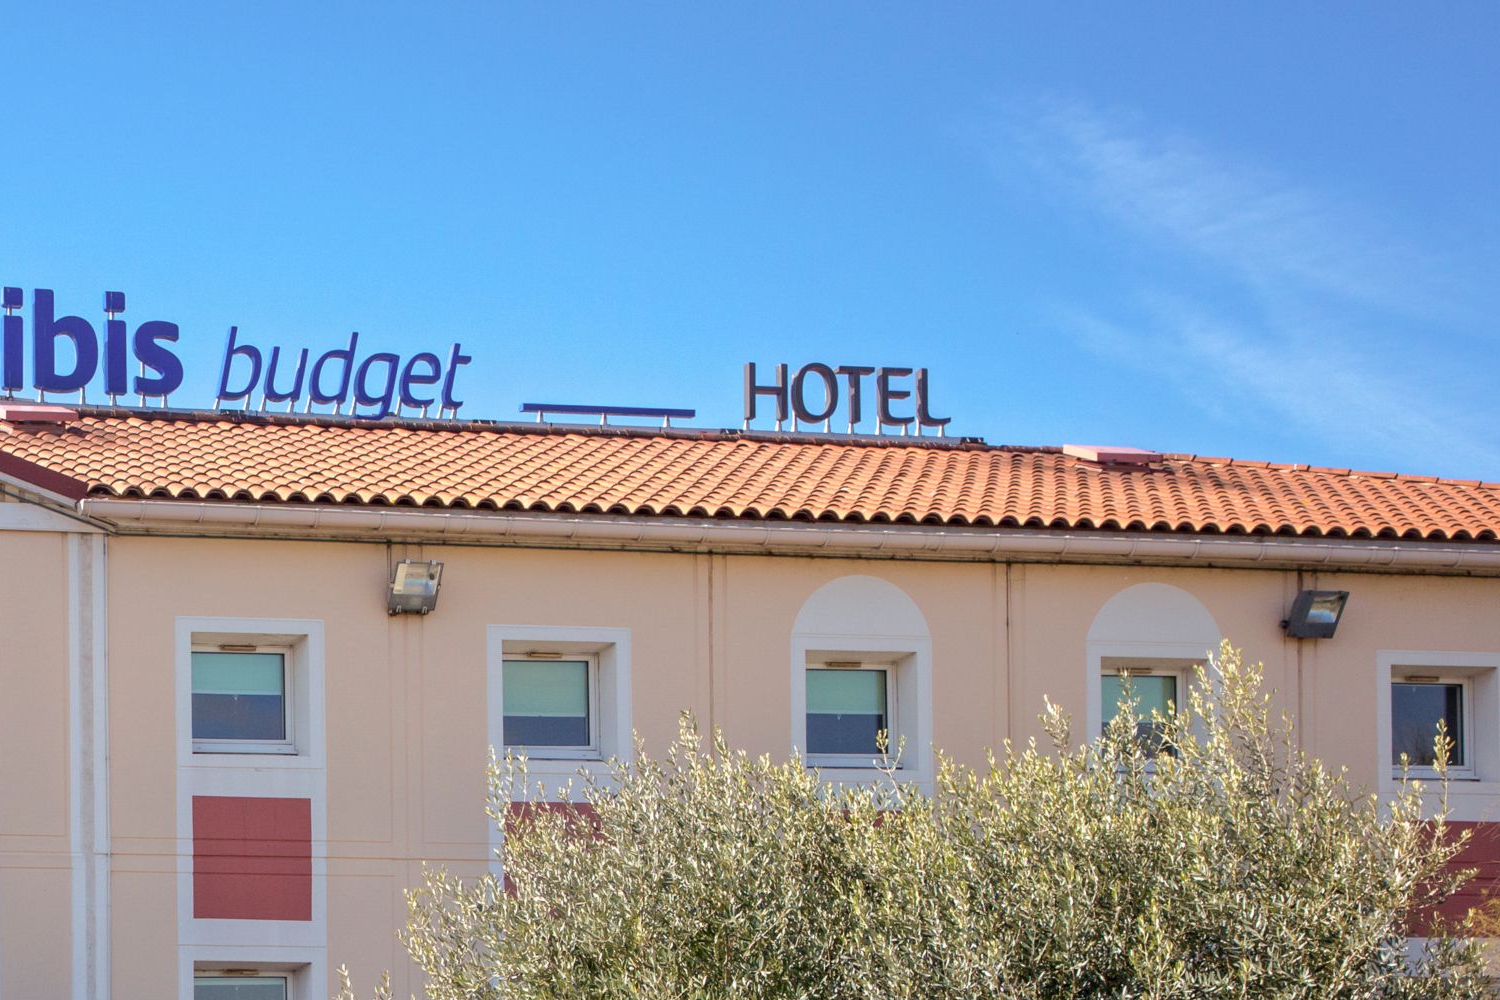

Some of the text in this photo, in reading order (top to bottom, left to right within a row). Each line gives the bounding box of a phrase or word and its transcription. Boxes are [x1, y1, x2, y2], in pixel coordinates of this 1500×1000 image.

[2, 286, 471, 420] ibis budget
[743, 362, 951, 426] HOTEL
